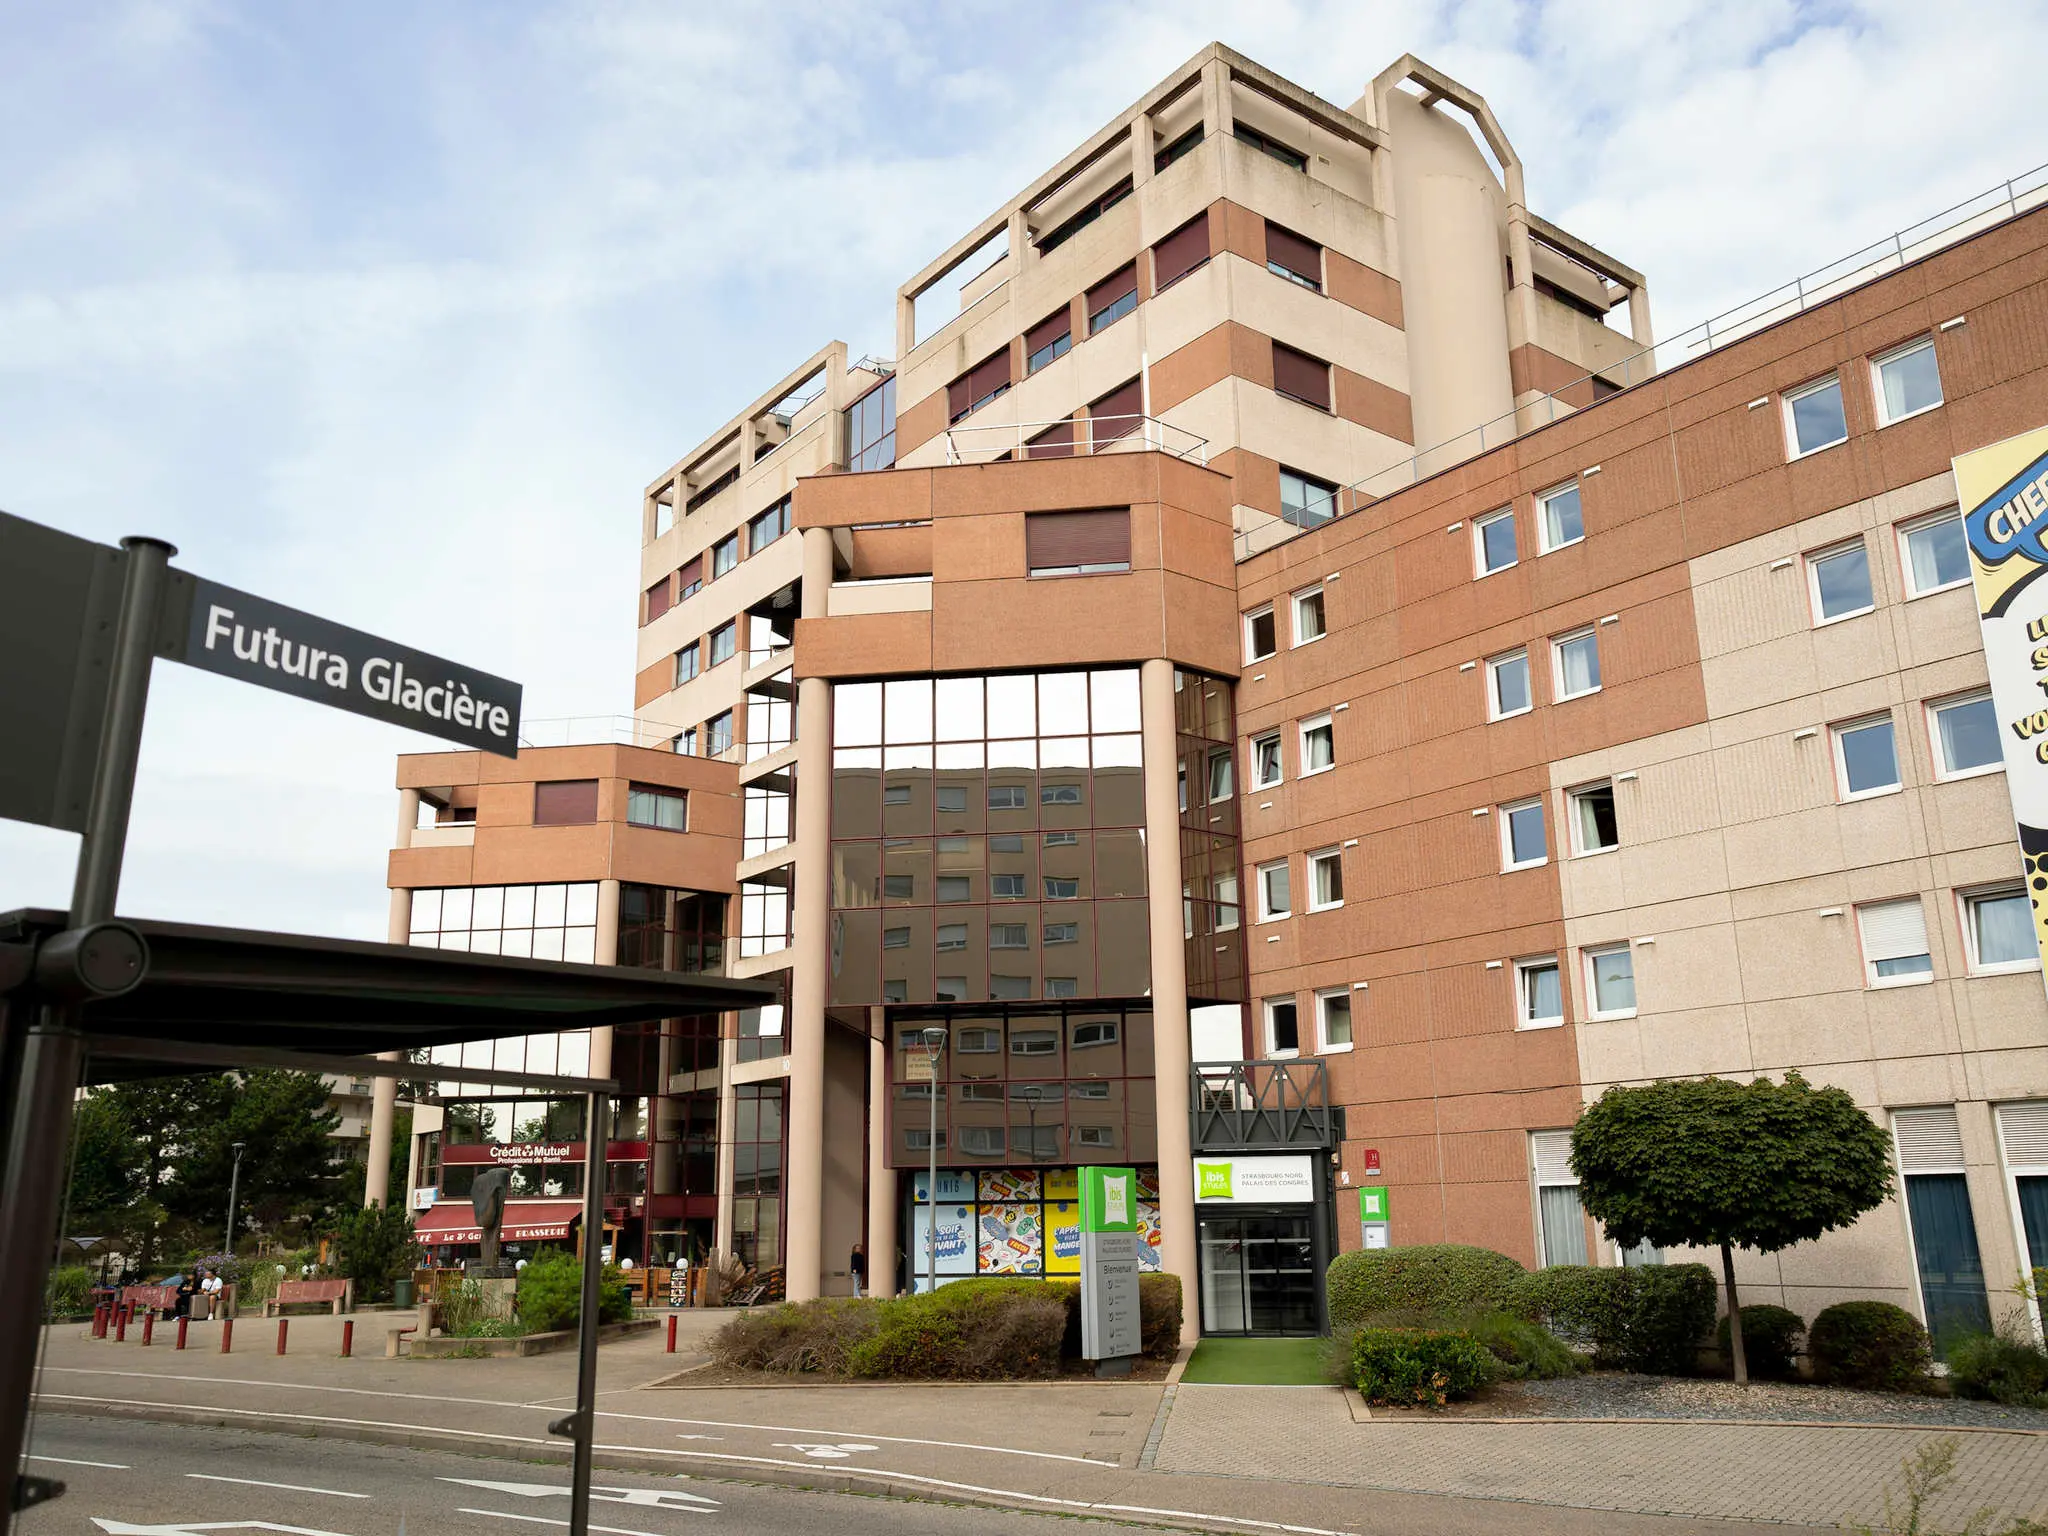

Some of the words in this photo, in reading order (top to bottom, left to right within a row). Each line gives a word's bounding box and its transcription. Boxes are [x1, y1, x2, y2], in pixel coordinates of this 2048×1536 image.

[204, 604, 349, 690] Futura
[360, 656, 511, 738] Glacière
[490, 1145, 521, 1157] Crédit
[534, 1145, 570, 1156] Mutuel
[1206, 1171, 1224, 1182] ibis
[1109, 1187, 1122, 1201] ibis
[515, 1227, 567, 1238] BRASSERIE
[939, 1224, 961, 1235] SOIF
